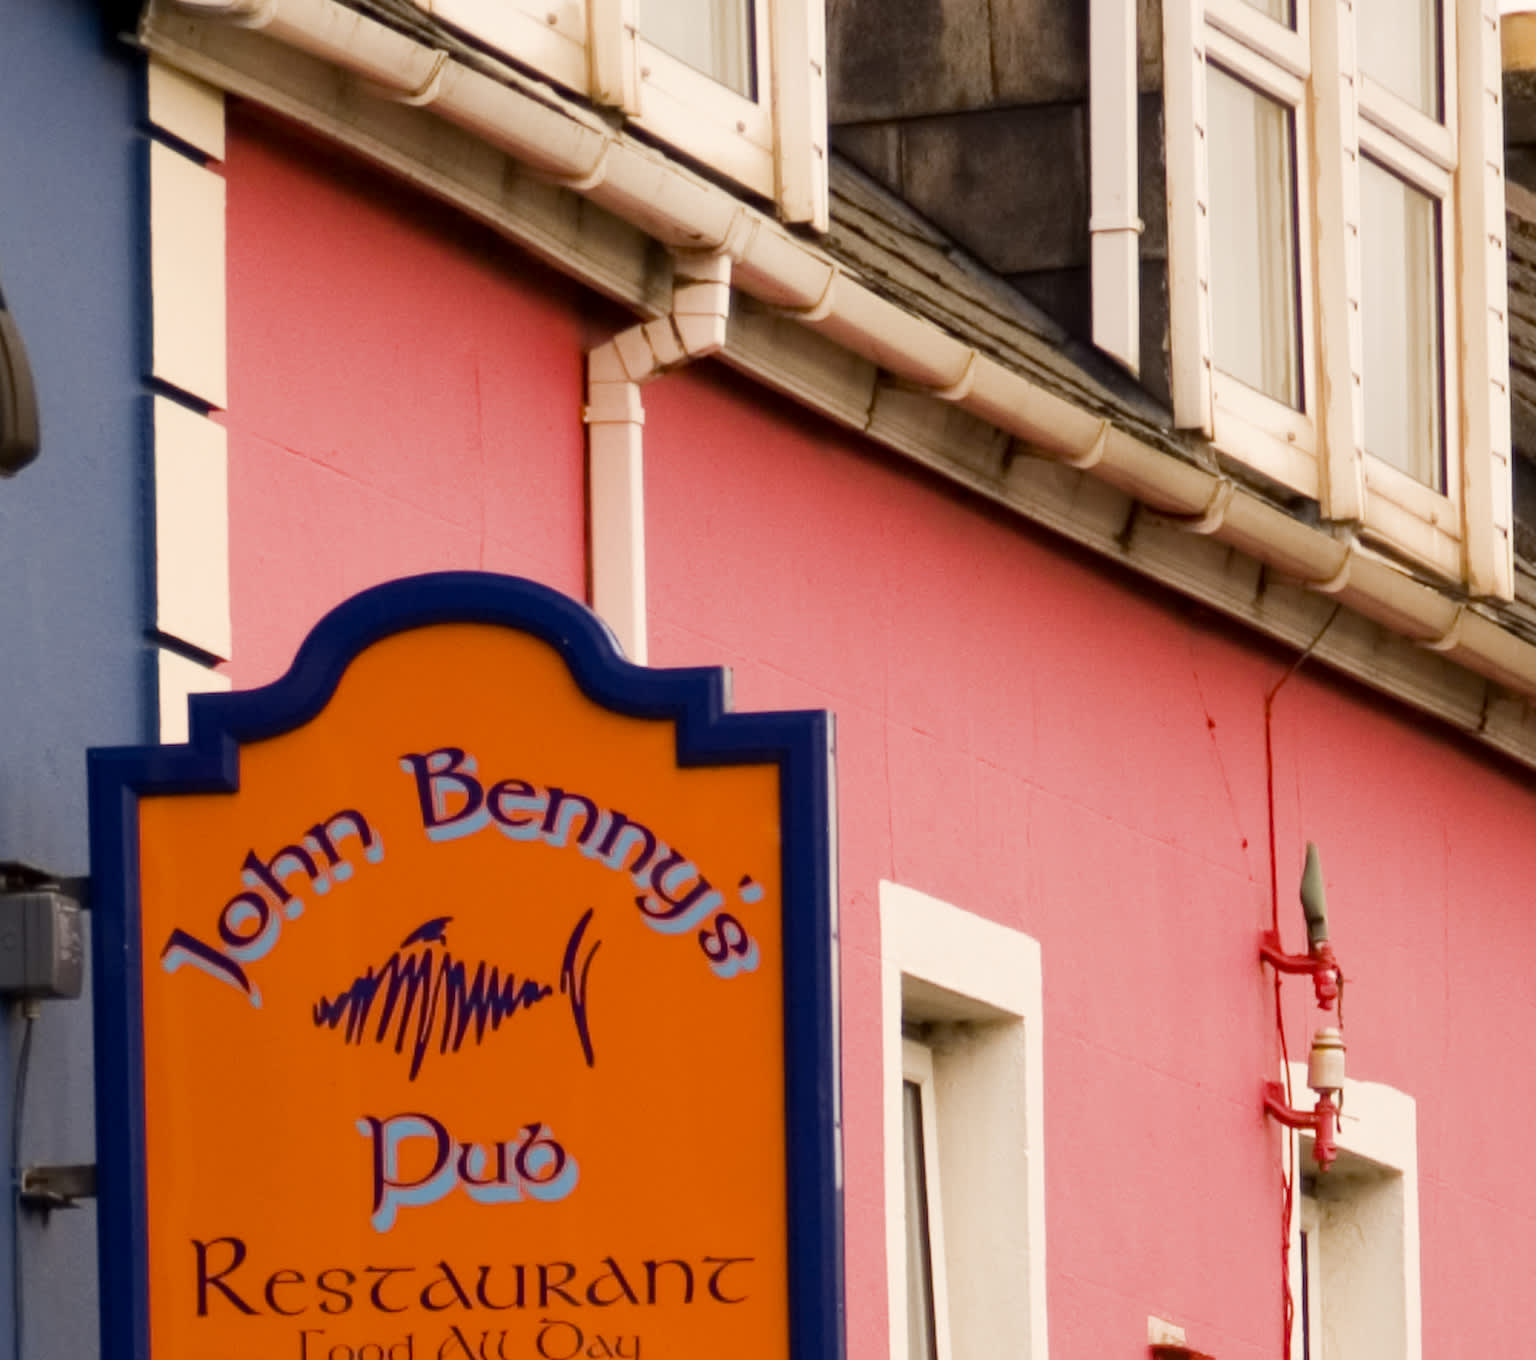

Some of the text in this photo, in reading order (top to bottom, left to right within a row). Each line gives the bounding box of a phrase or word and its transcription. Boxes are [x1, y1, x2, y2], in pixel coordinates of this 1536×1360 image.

[164, 746, 762, 1003] John Benny's
[359, 1112, 572, 1226] Pub
